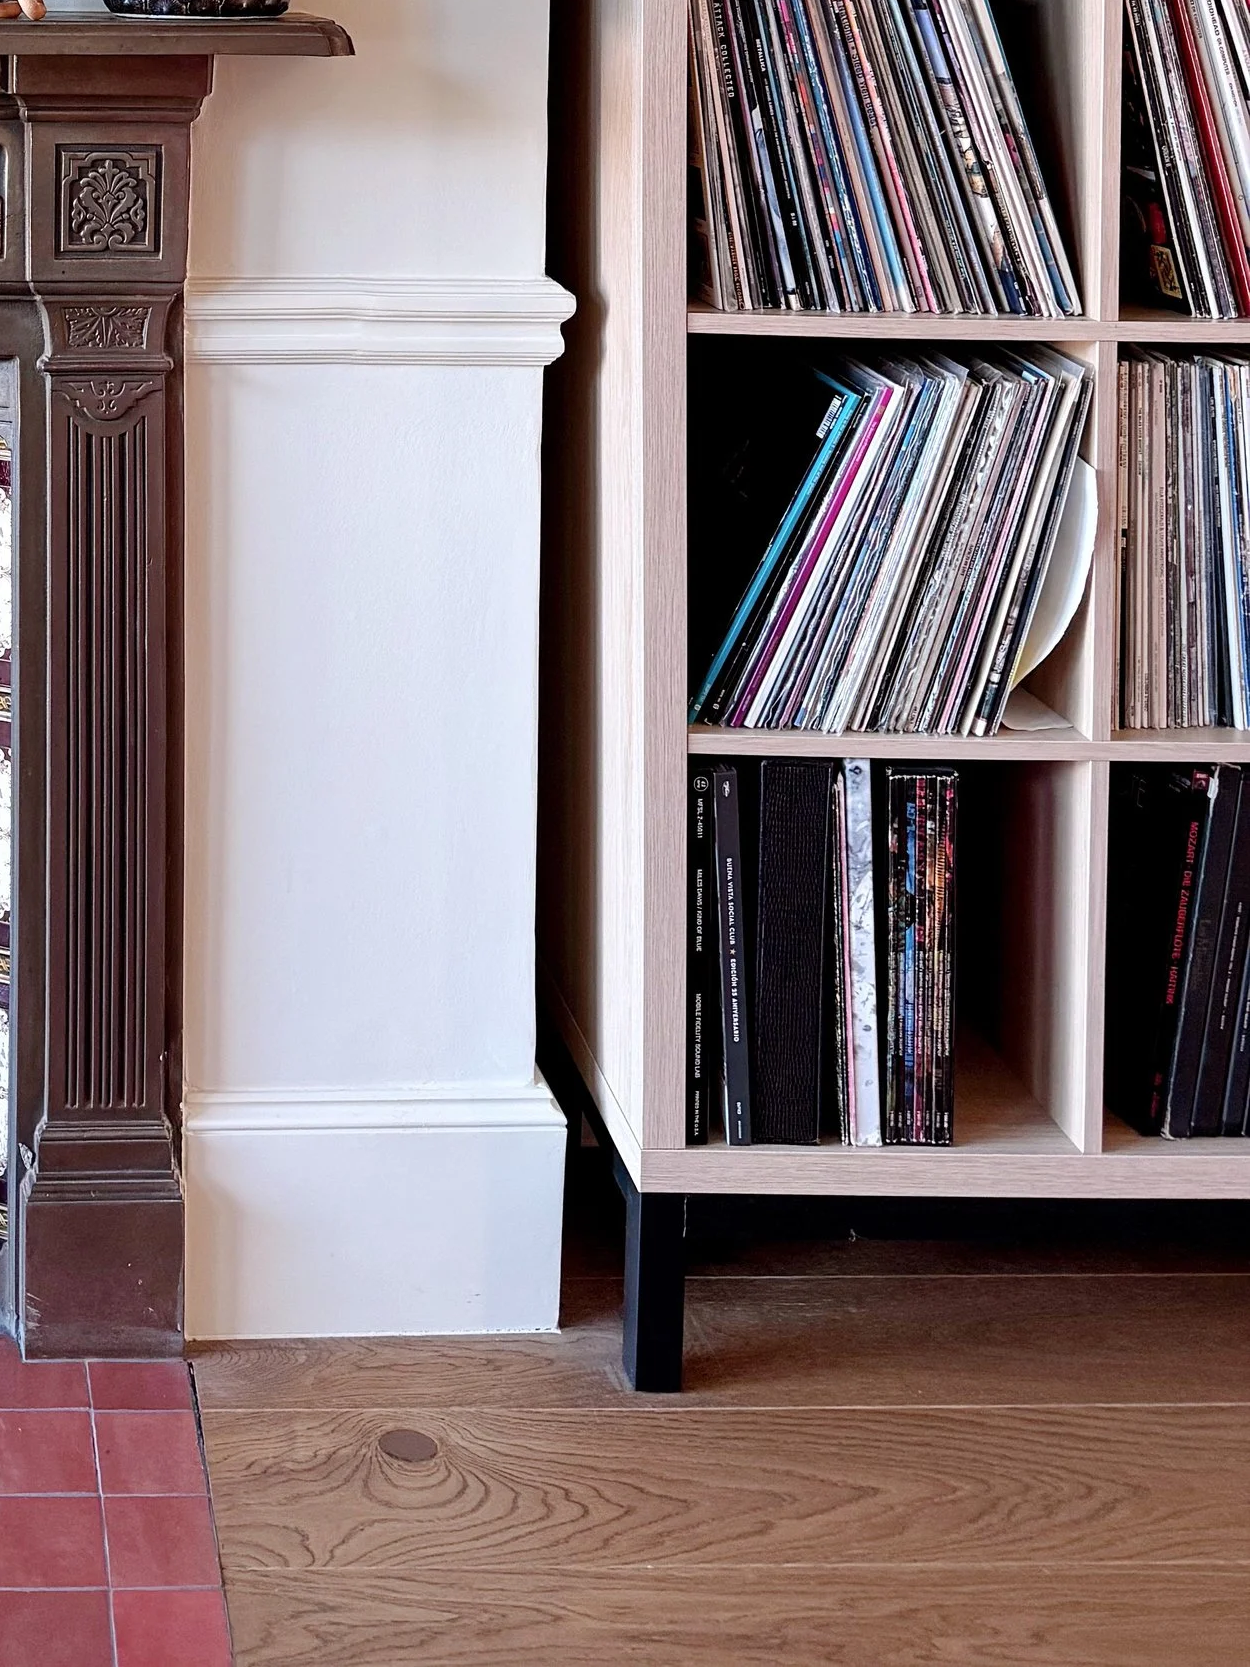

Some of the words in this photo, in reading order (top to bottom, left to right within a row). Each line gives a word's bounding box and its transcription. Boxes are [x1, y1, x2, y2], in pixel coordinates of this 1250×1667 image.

[712, 1, 724, 38] ATTACK
[718, 44, 732, 98] COLLECTED
[755, 38, 767, 72] METALLICA
[837, 4, 856, 44] National
[850, 52, 866, 80] Sleep
[1218, 46, 1231, 76] COMPUTER
[1186, 822, 1199, 864] MOZART
[1182, 870, 1192, 886] DIE
[696, 926, 702, 934] OF
